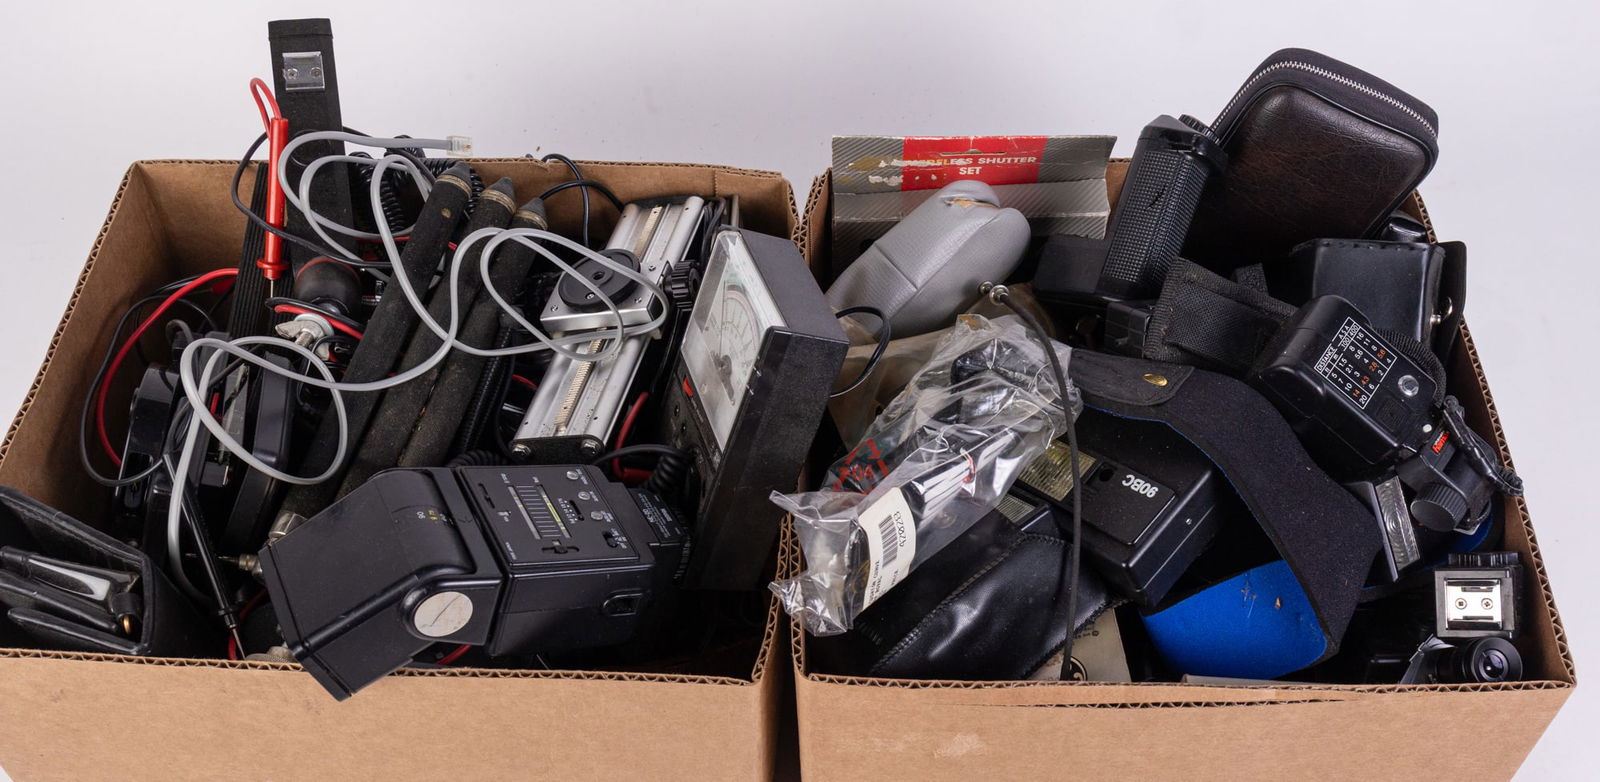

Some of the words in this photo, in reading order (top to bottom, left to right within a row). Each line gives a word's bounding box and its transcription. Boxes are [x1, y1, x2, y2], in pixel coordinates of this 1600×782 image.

[978, 156, 1037, 164] SHUTTER
[959, 166, 982, 175] SET
[1349, 325, 1357, 335] 400
[1316, 347, 1335, 370] DISTANCE
[1344, 382, 1352, 390] 10
[1359, 394, 1367, 403] 20
[1122, 474, 1158, 498] 90BC
